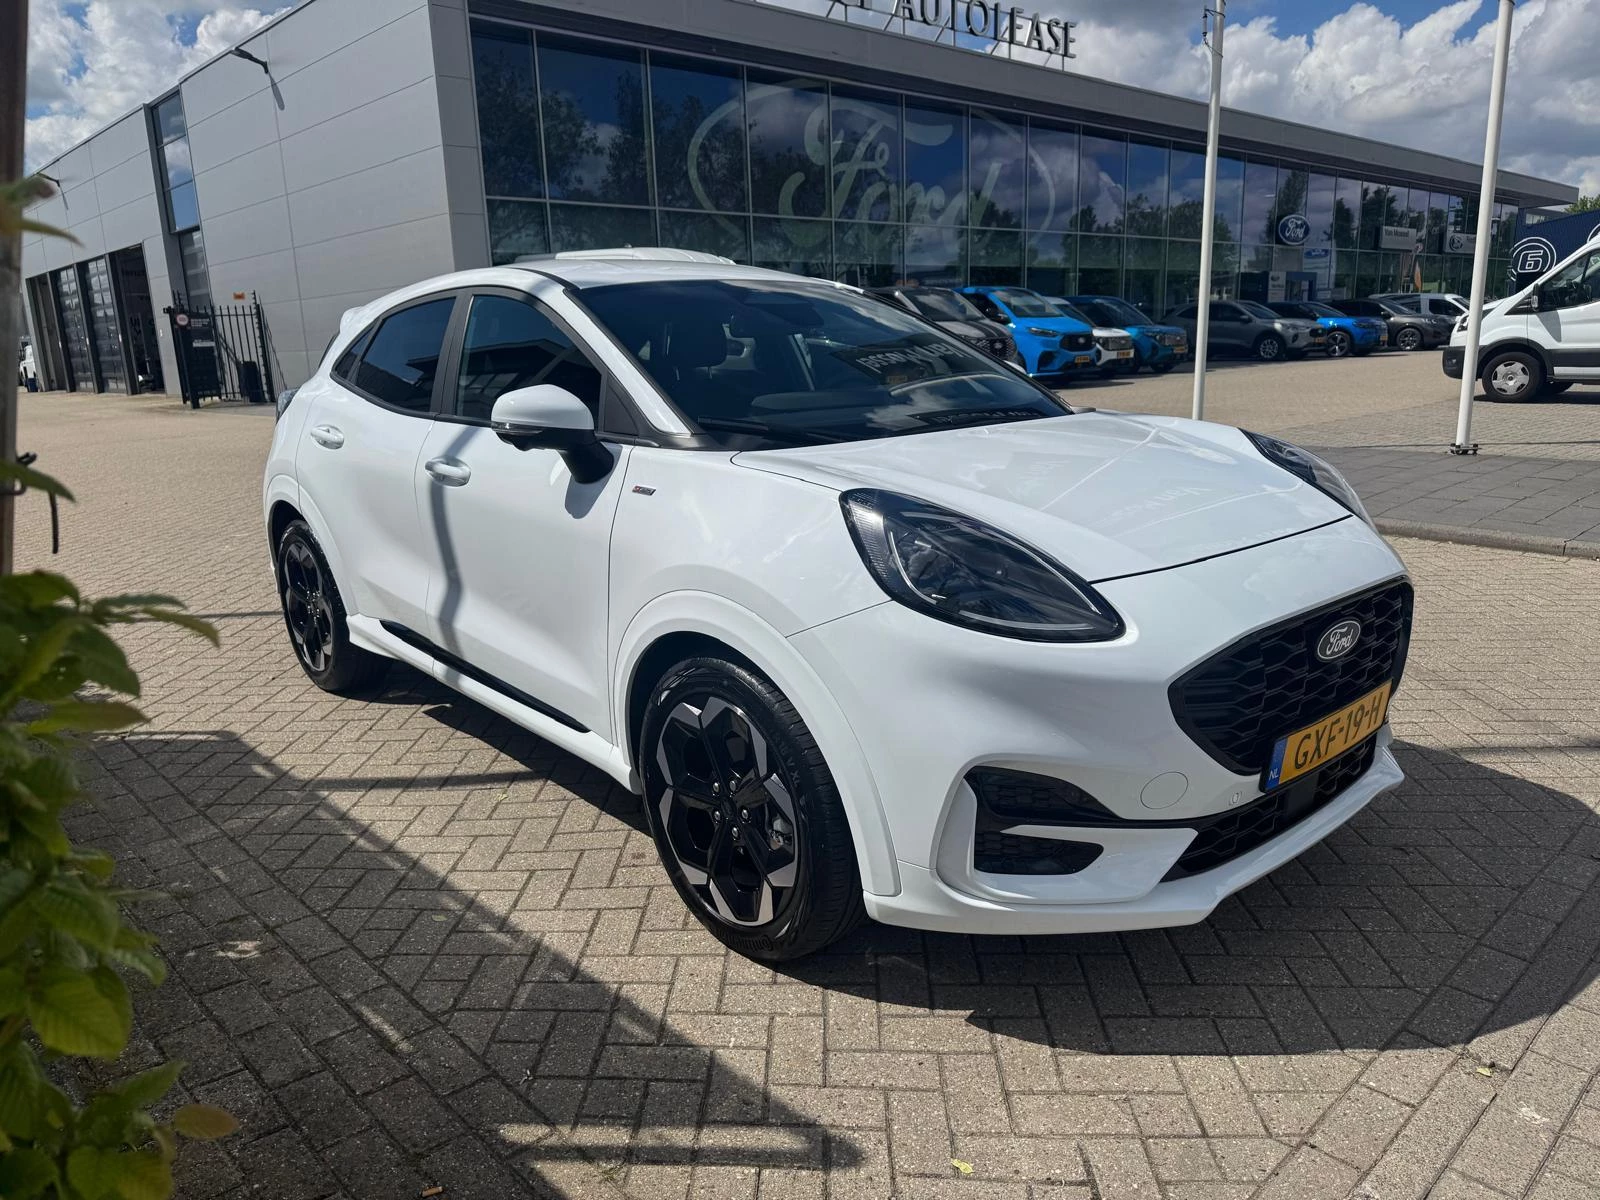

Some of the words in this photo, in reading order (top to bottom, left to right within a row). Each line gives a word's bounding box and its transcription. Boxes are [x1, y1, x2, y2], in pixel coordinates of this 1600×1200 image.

[779, 100, 1002, 252] Ford
[1326, 626, 1354, 655] Ford
[1294, 691, 1384, 770] GXF-19-H
[1269, 766, 1280, 781] NL
